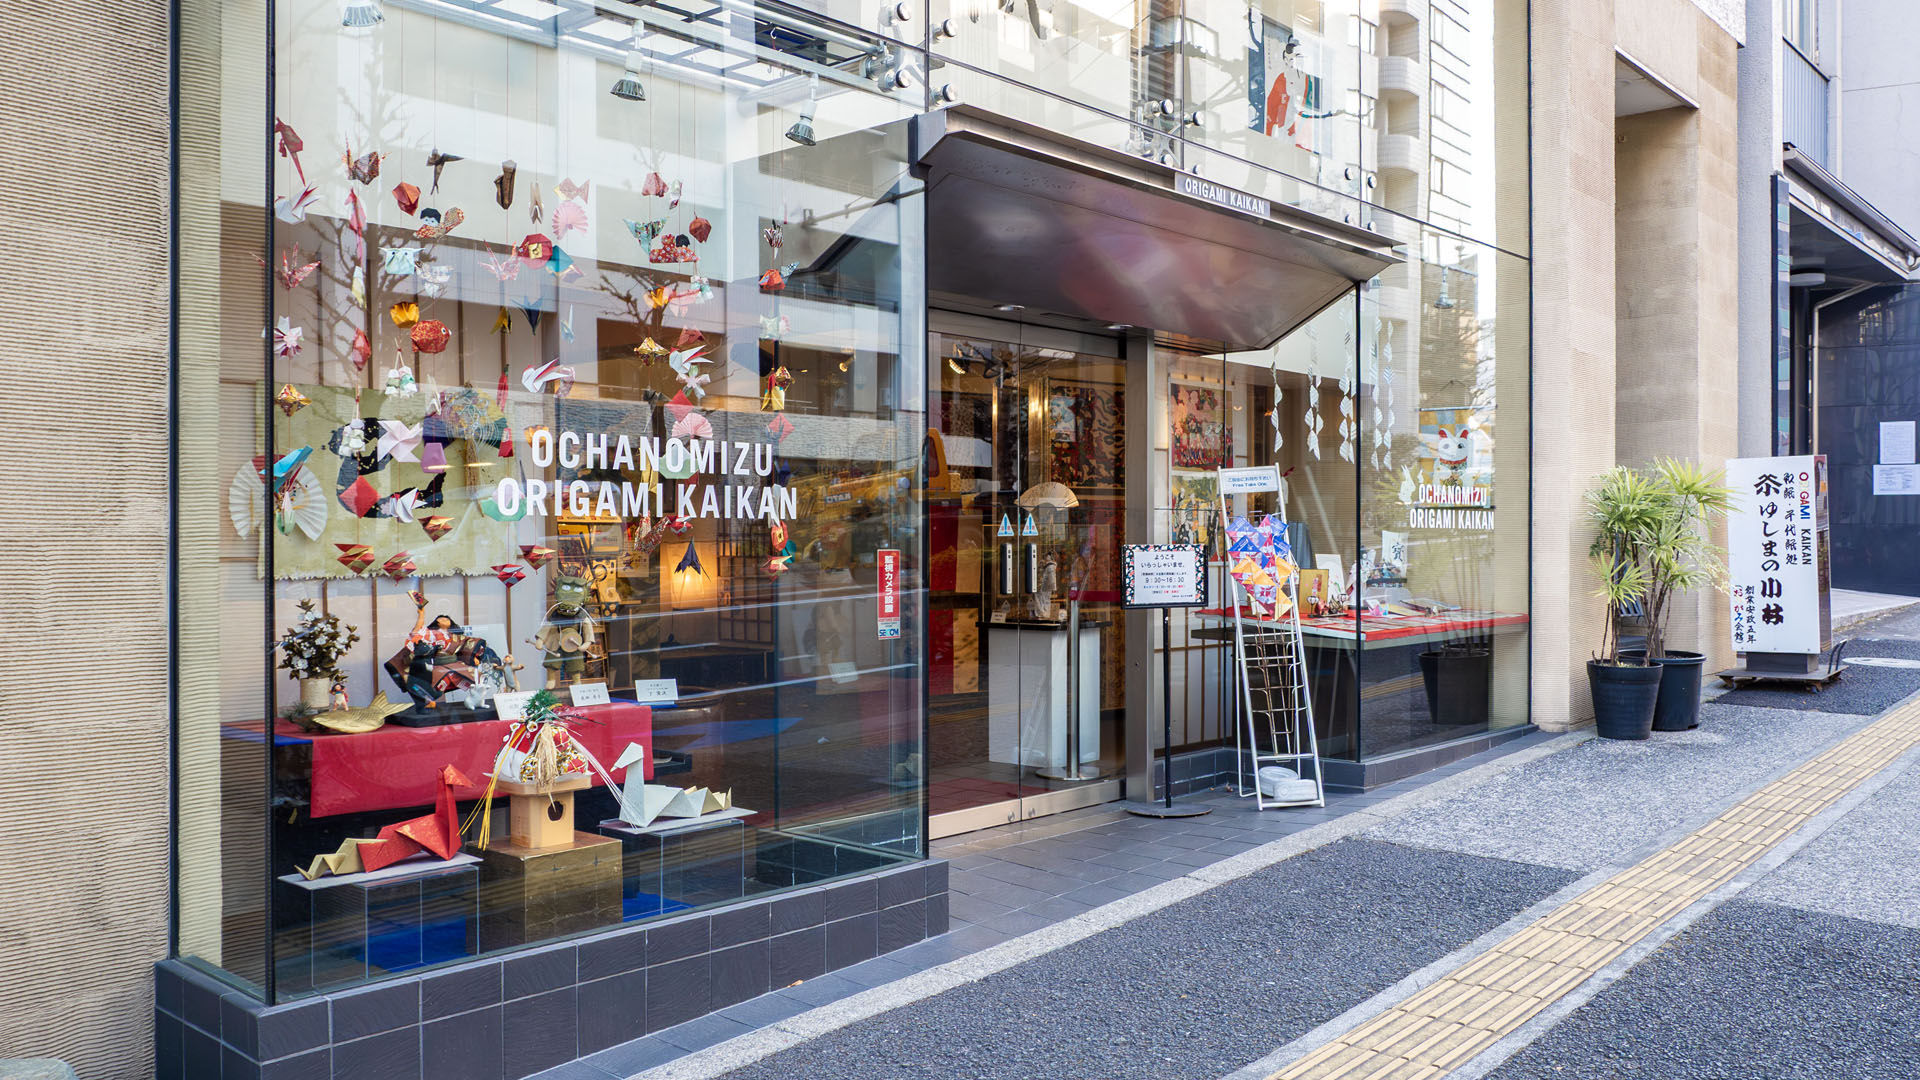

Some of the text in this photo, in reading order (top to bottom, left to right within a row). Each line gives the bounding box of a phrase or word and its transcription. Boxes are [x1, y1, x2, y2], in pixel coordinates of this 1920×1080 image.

[1185, 178, 1265, 214] ORIGAMI KAIKAN
[531, 429, 774, 477] OCHANOMIZU
[497, 477, 798, 520] ORIGAMI KAIKAN
[1418, 484, 1487, 506] OCHANOMIZU
[1409, 508, 1494, 530] ORIGAMI KAIKAN
[1801, 528, 1812, 565] KAIKAN
